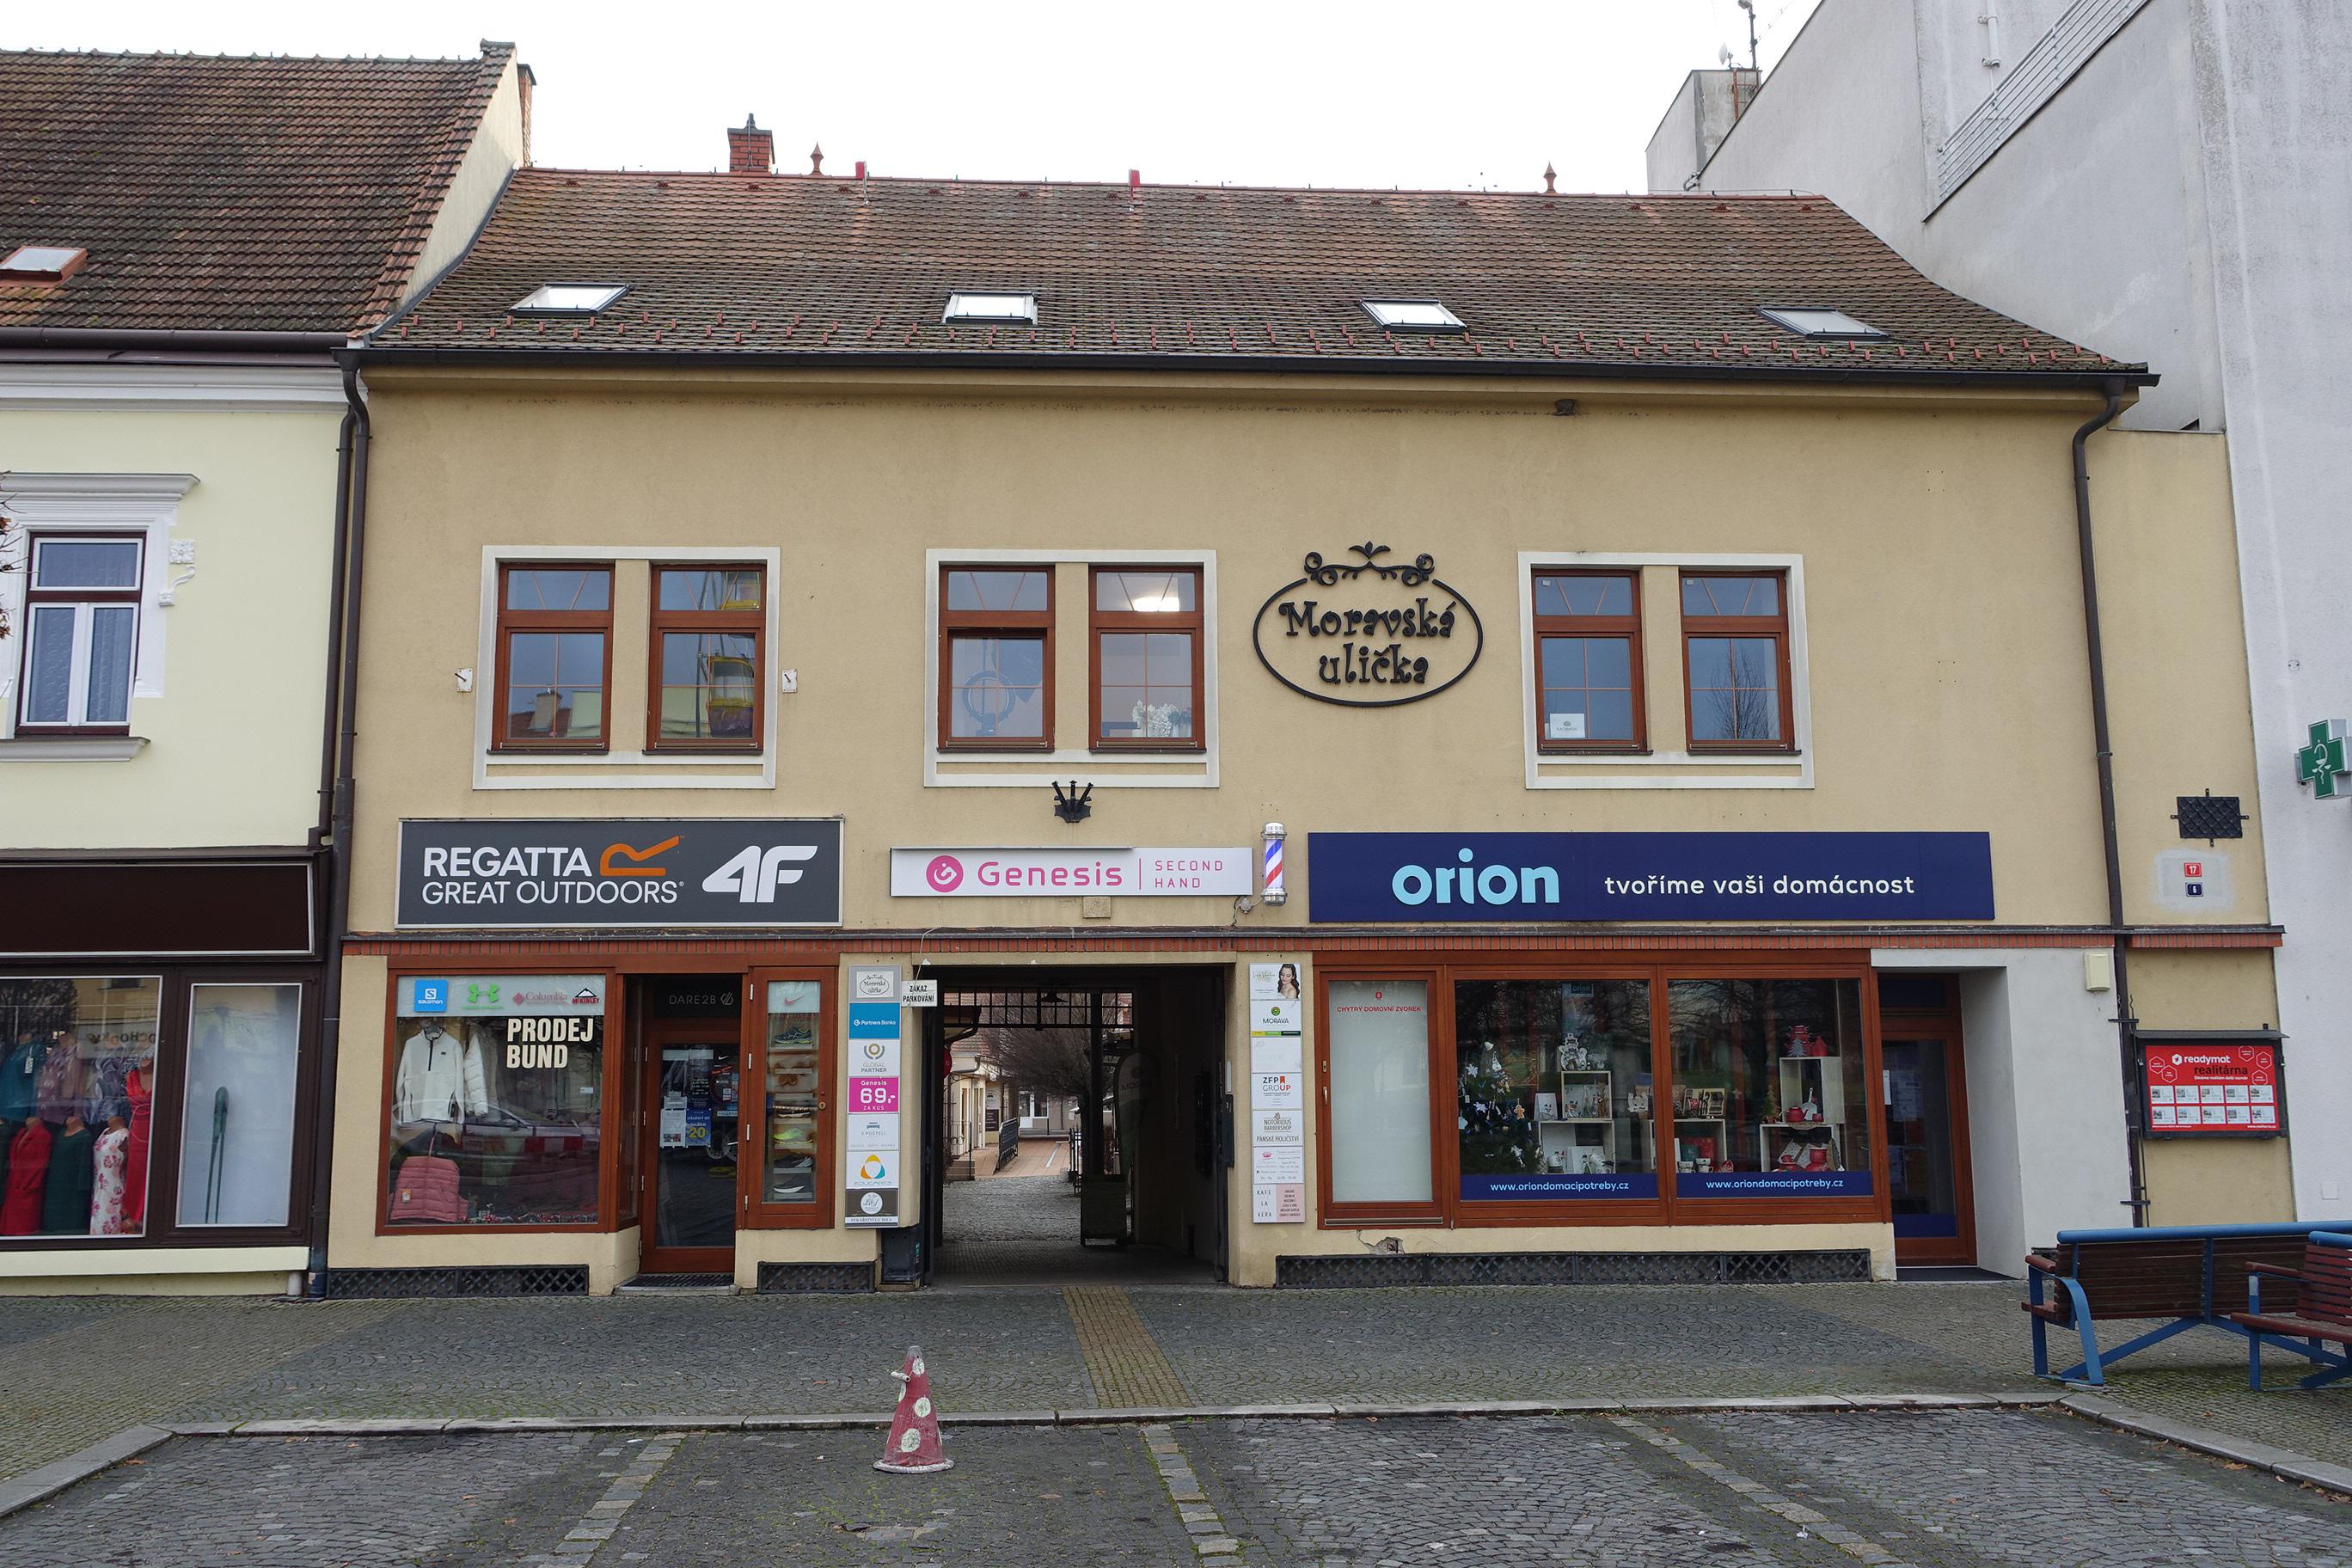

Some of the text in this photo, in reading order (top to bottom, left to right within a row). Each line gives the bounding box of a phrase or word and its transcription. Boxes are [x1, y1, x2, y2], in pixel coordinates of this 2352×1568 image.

[1278, 597, 1457, 638] Moravská
[1319, 642, 1429, 684] ulička
[423, 846, 593, 878] REGATTA
[701, 845, 818, 903] 4F
[977, 861, 1124, 887] Genesis
[1155, 860, 1224, 872] SECOND
[2189, 865, 2197, 874] 17
[1155, 877, 1202, 889] HAND
[1391, 847, 1560, 905] orion
[1604, 873, 1915, 896] tvoříme vaši domácnost
[421, 880, 512, 905] GREAT
[903, 993, 934, 1002] PARKOVÁNÍ
[506, 1018, 594, 1043] PRODEJ
[505, 1044, 569, 1069] BUND
[2184, 1055, 2231, 1065] readymat
[2194, 1065, 2248, 1075] realitárna
[1490, 1180, 1630, 1193] www.oriondomacipotreby.cz
[1706, 1178, 1845, 1191] www.oriondomacipotreby.cz
